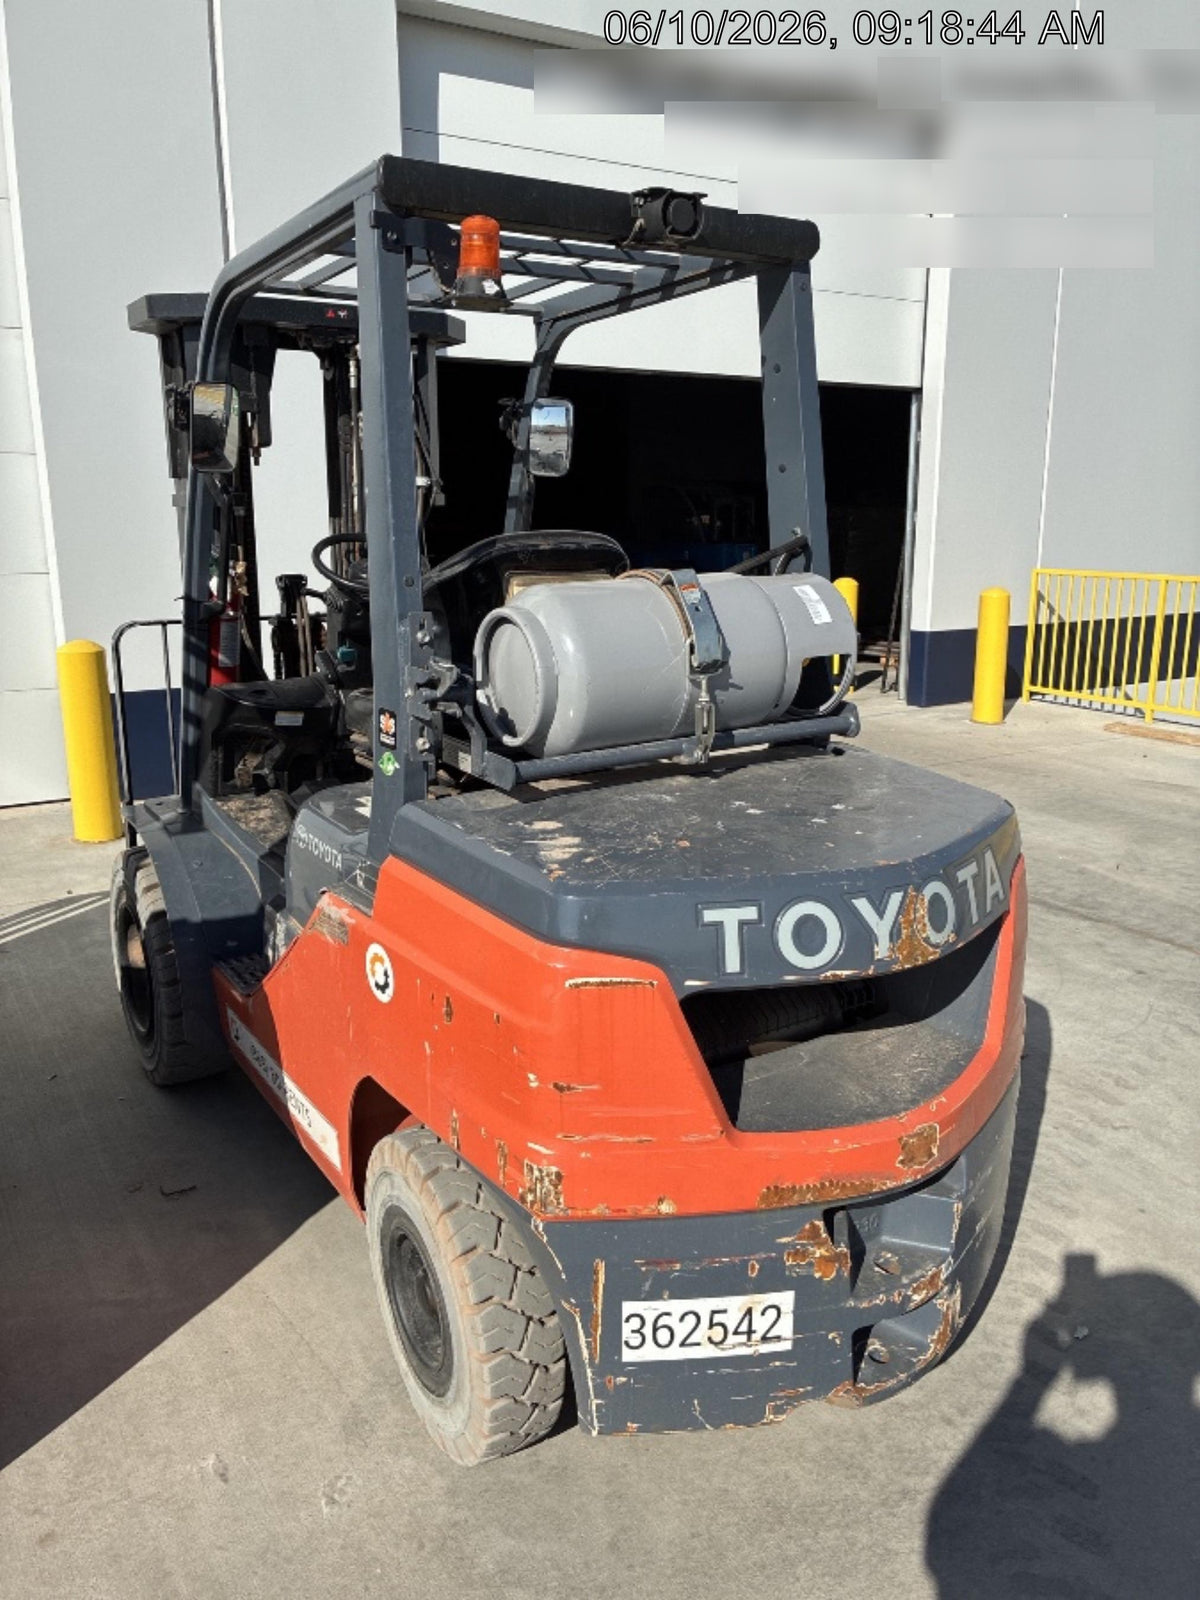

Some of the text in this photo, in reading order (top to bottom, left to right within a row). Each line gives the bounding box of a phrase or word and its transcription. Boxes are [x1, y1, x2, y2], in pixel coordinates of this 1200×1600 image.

[308, 832, 343, 871] TOYOTA
[701, 846, 1007, 974] TOYOTA
[623, 1304, 783, 1350] 362542
